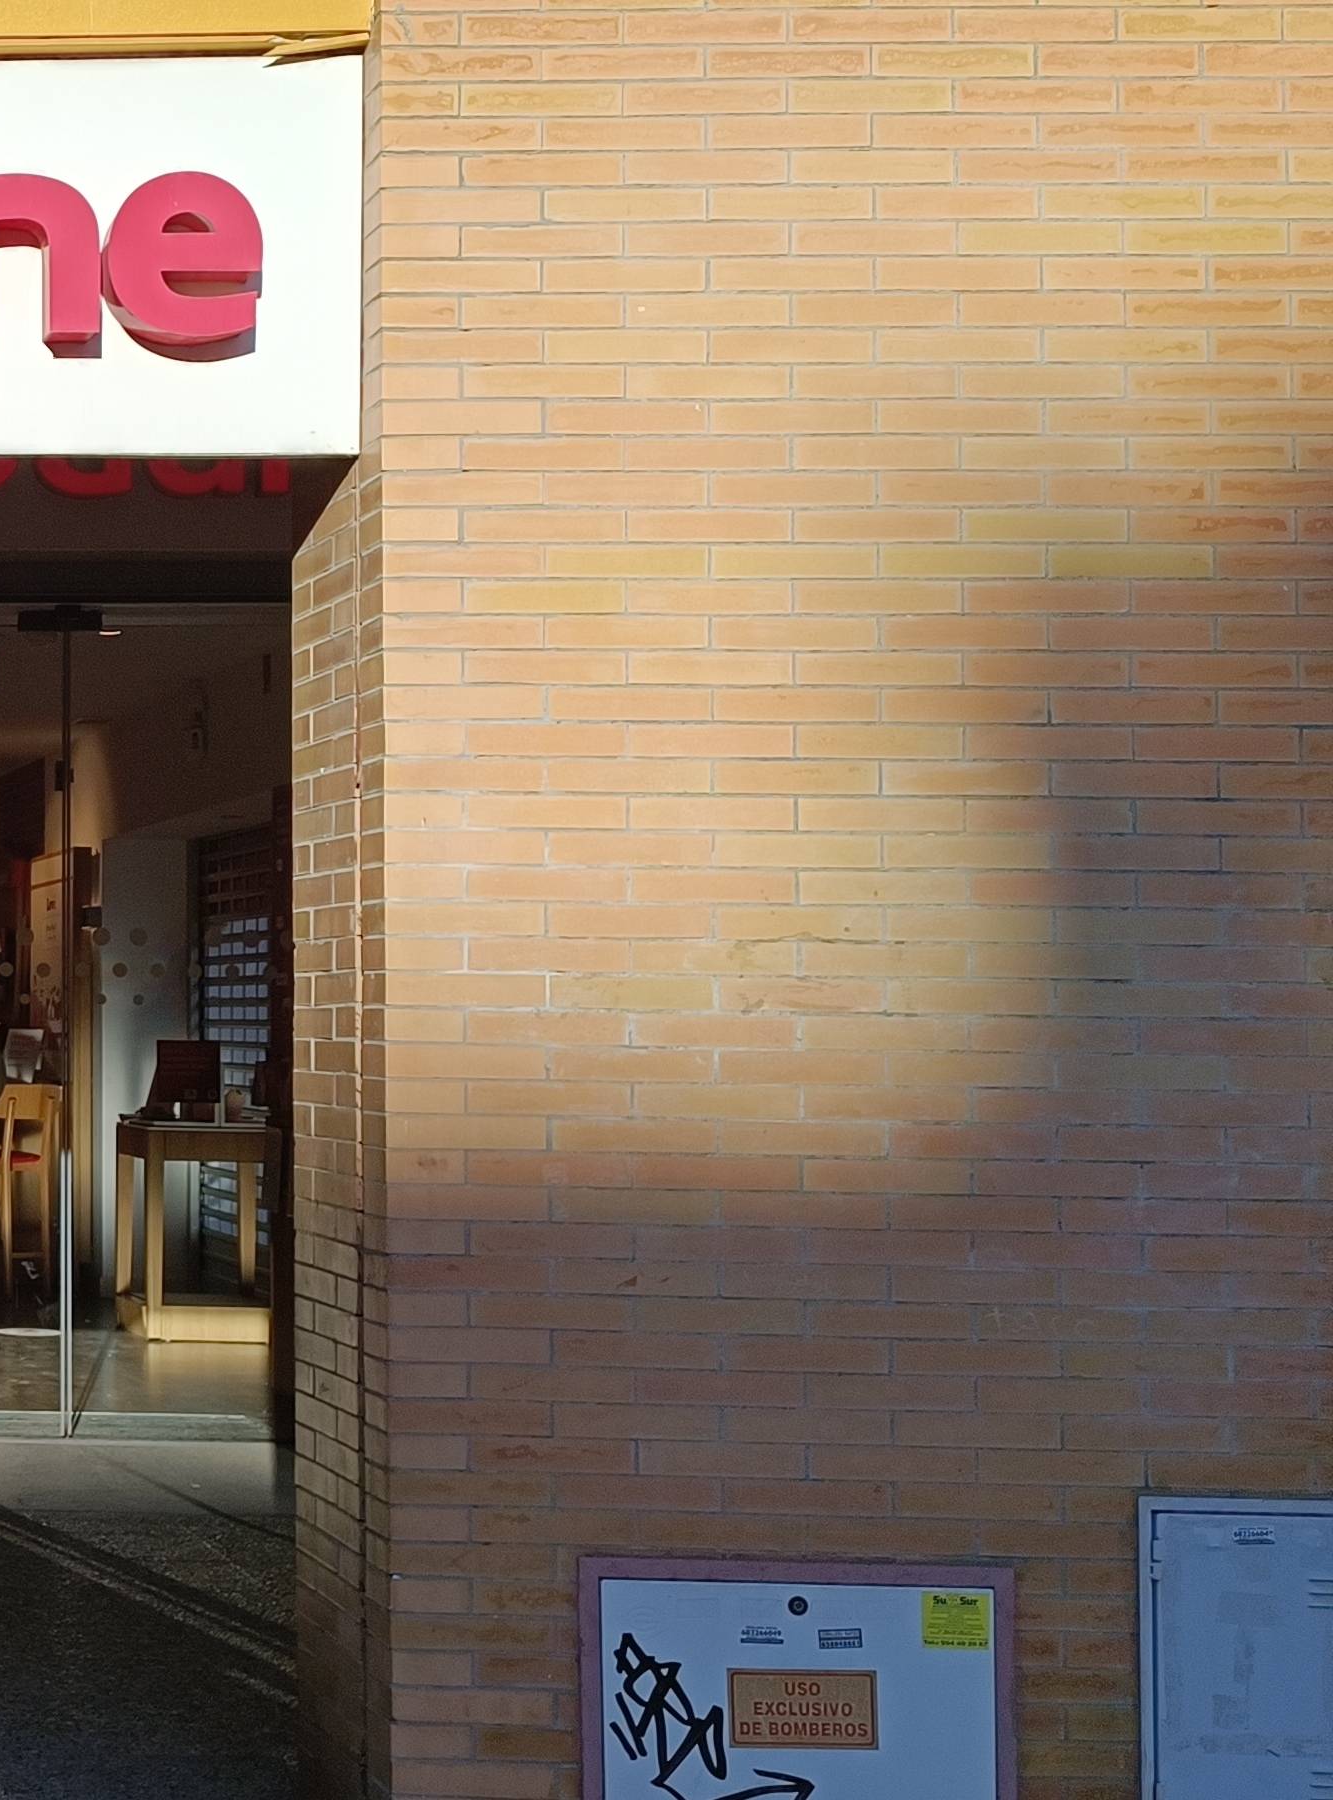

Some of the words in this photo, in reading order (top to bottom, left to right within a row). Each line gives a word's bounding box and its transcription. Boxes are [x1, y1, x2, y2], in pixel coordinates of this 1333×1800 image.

[784, 1681, 821, 1697] USO
[753, 1701, 853, 1717] EXCLUSIVO
[739, 1721, 763, 1736] DE
[768, 1721, 869, 1738] BOMBEROS
